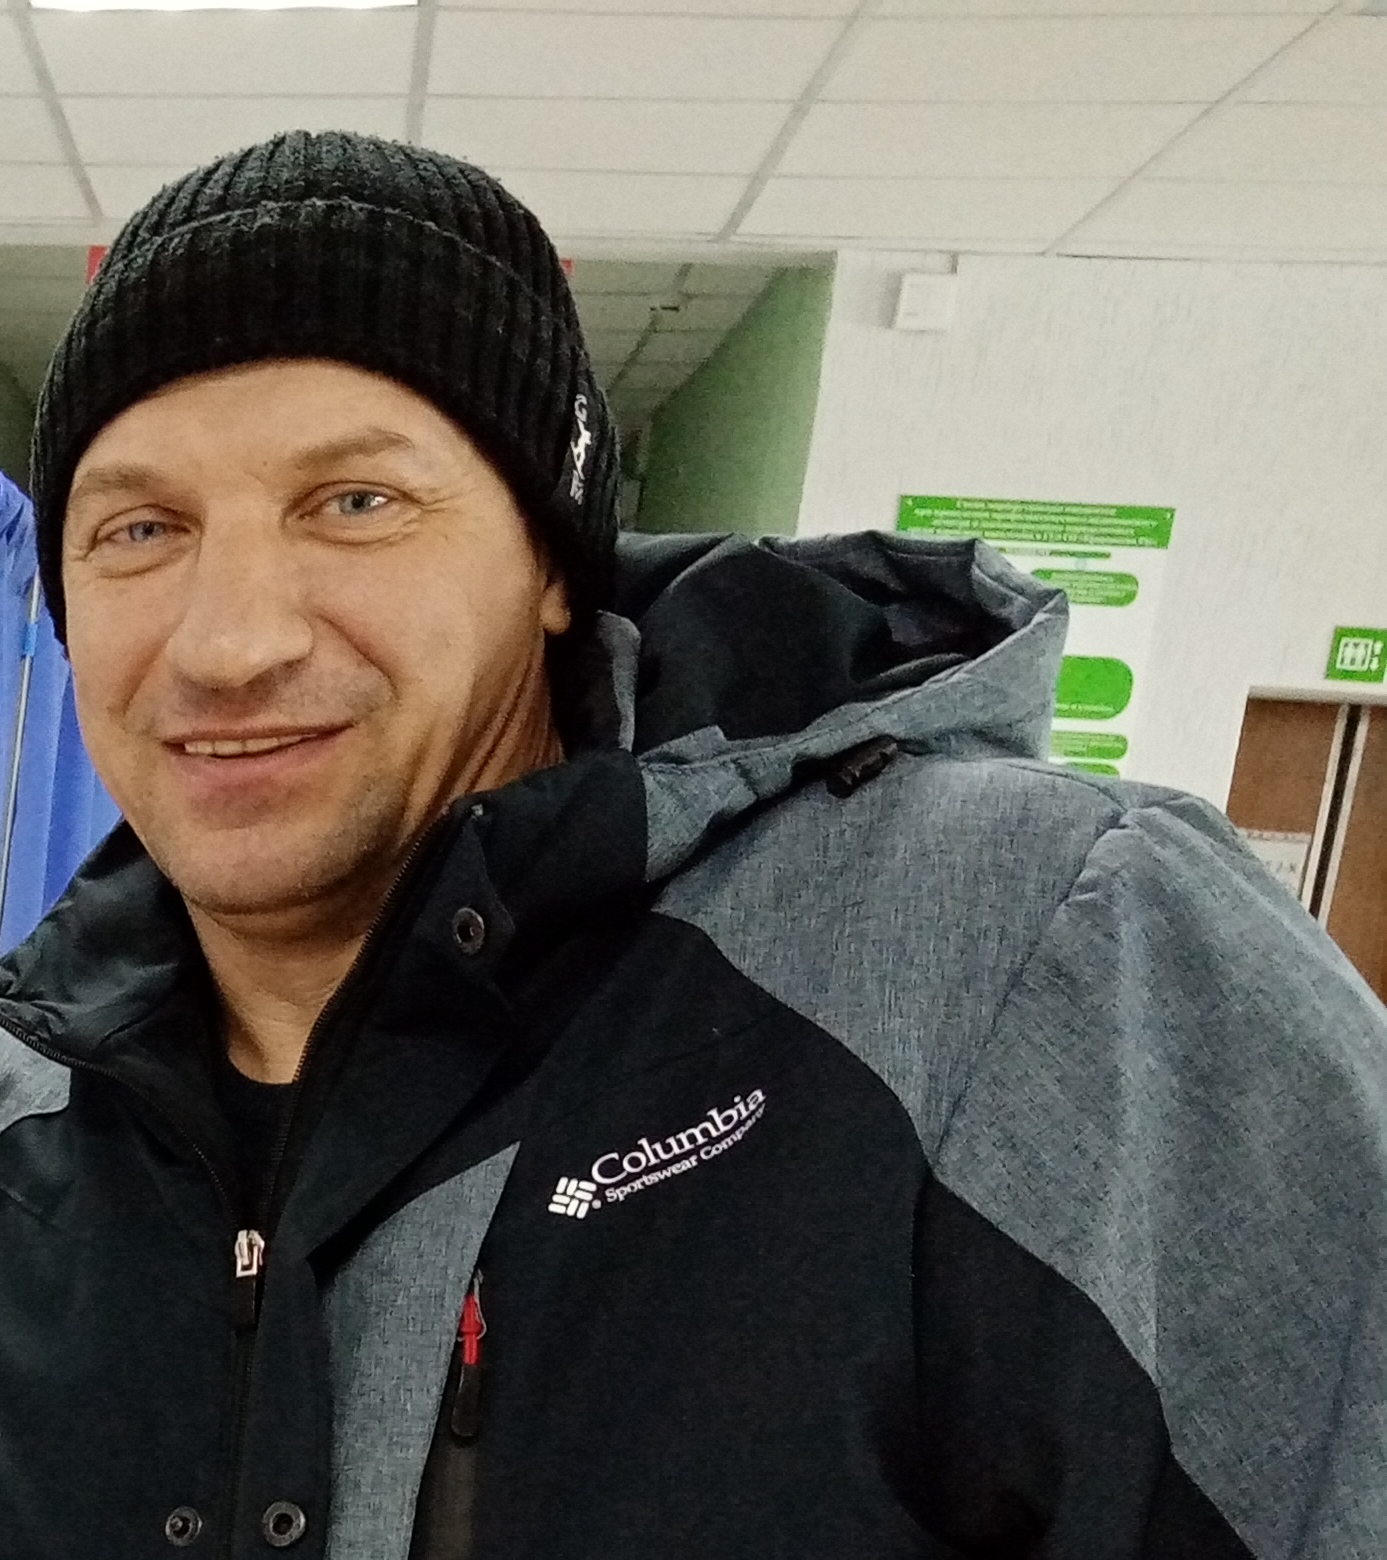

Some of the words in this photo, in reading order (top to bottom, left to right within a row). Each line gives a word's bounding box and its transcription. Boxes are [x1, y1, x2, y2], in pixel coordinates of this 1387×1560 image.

[591, 1087, 767, 1185] Columbia
[604, 1154, 698, 1203] Sportswear
[700, 1102, 767, 1161] Company
